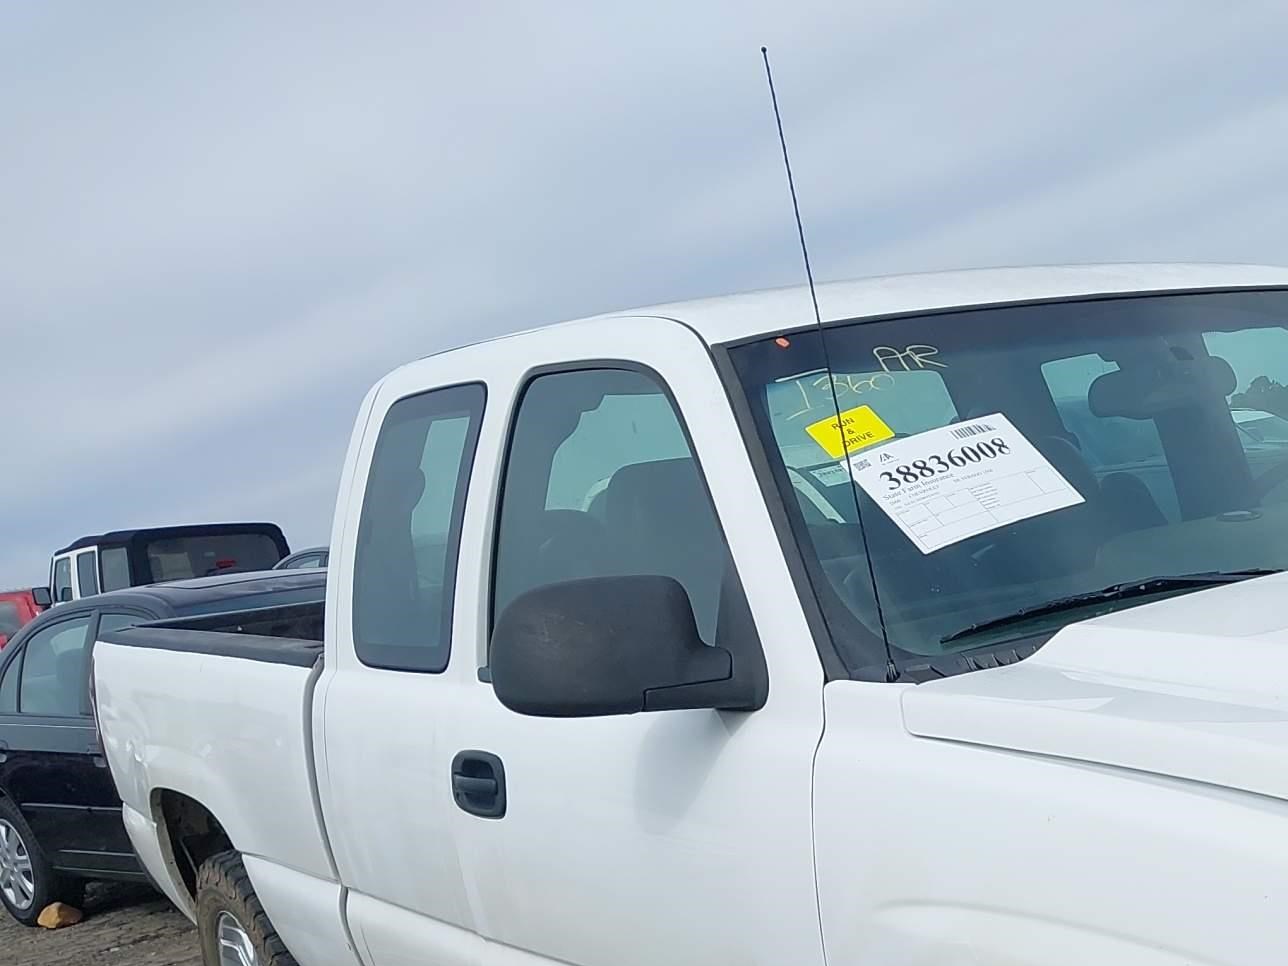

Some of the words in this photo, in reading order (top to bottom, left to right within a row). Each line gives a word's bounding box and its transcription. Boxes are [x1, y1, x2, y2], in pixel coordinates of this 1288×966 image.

[831, 417, 855, 430] RUN
[842, 431, 874, 447] DRIVE
[879, 436, 1011, 490] 38836008
[882, 489, 902, 500] State
[901, 482, 922, 494] Farm
[920, 473, 955, 486] Insurance
